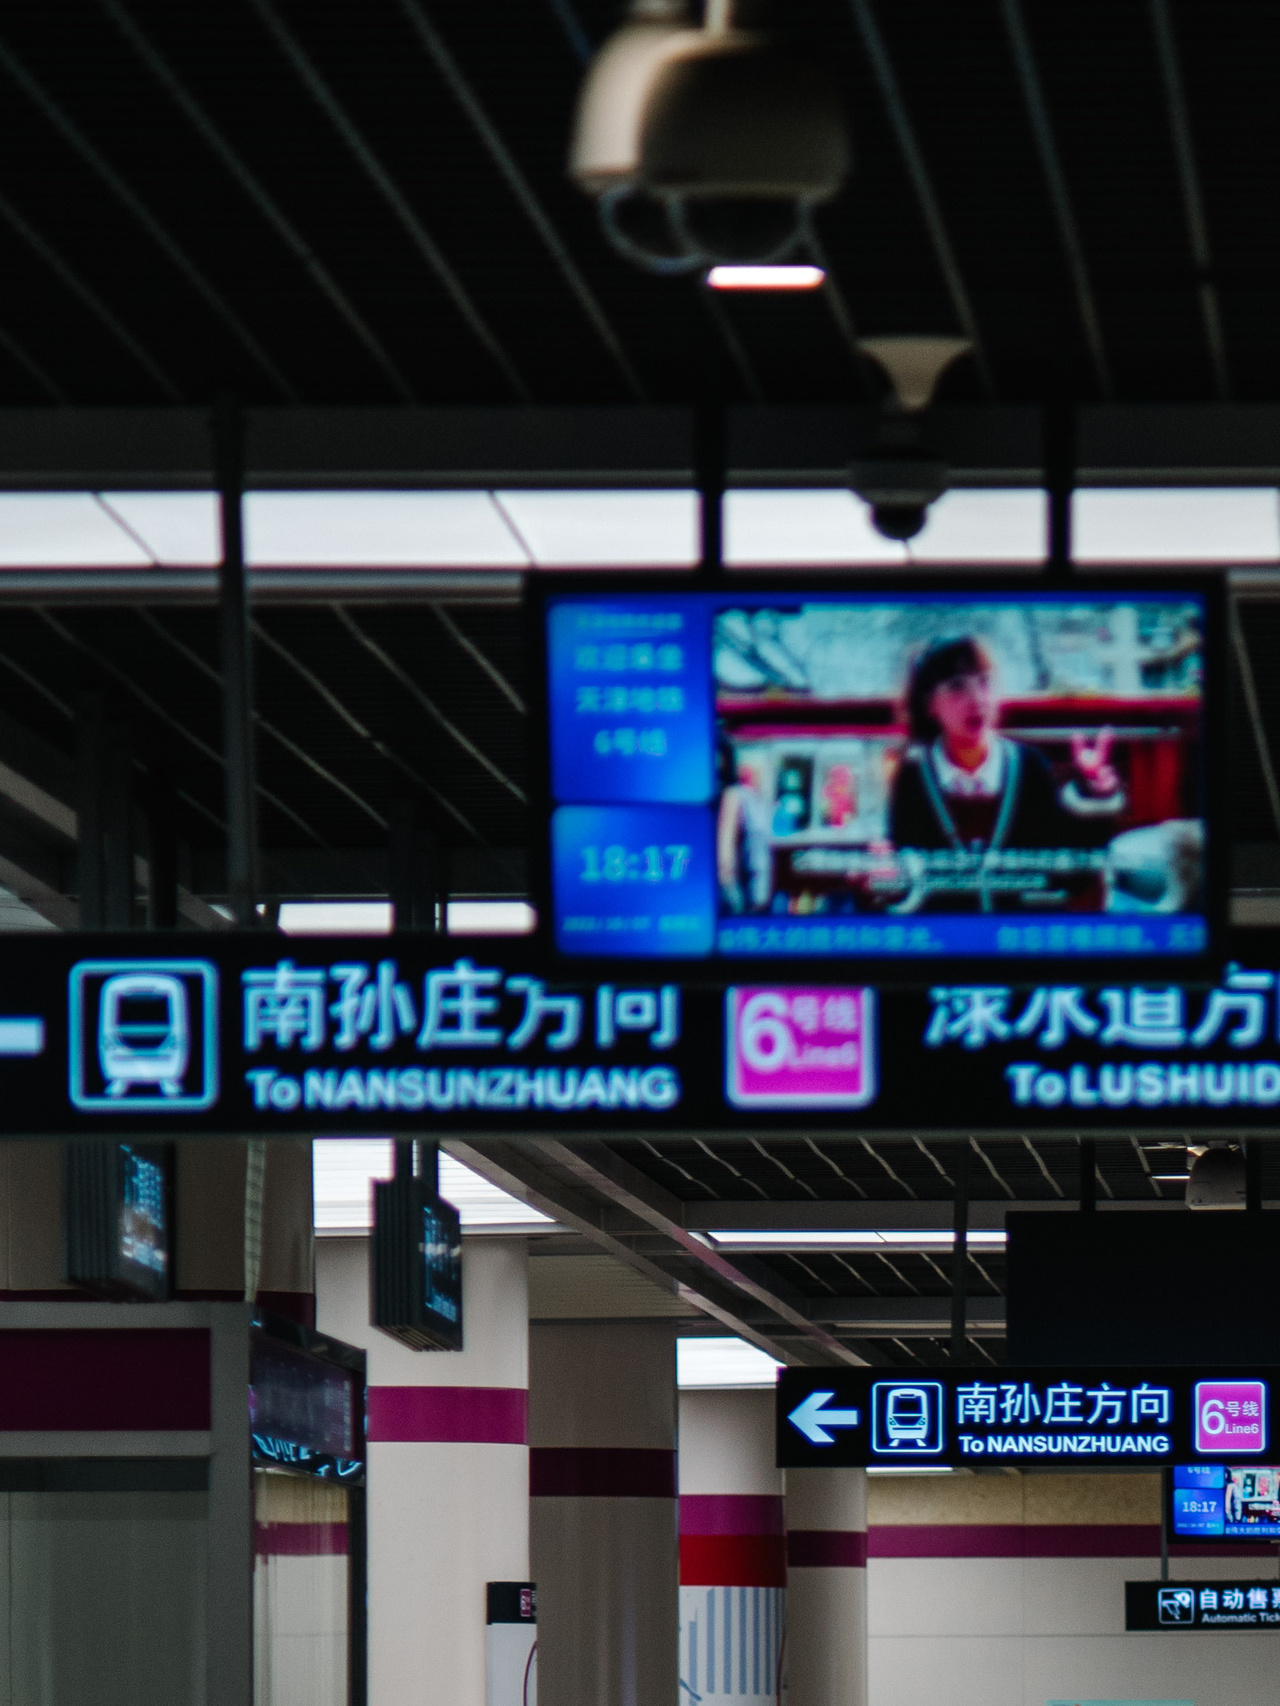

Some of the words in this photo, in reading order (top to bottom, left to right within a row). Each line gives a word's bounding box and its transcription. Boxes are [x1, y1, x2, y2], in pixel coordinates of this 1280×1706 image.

[579, 844, 691, 882] 18:17
[241, 958, 680, 1052] 南孙庄方向
[246, 1069, 301, 1108] To
[304, 1068, 679, 1108] NANSUNZHUANG
[1008, 1063, 1066, 1104] To
[956, 1382, 1170, 1424] 南孙庄方向
[958, 1435, 987, 1453] To
[988, 1435, 1170, 1453] NANSUNZHUANG
[1224, 1423, 1259, 1434] Line6
[1182, 1501, 1217, 1513] 18:17
[1202, 1612, 1257, 1623] Automatic
